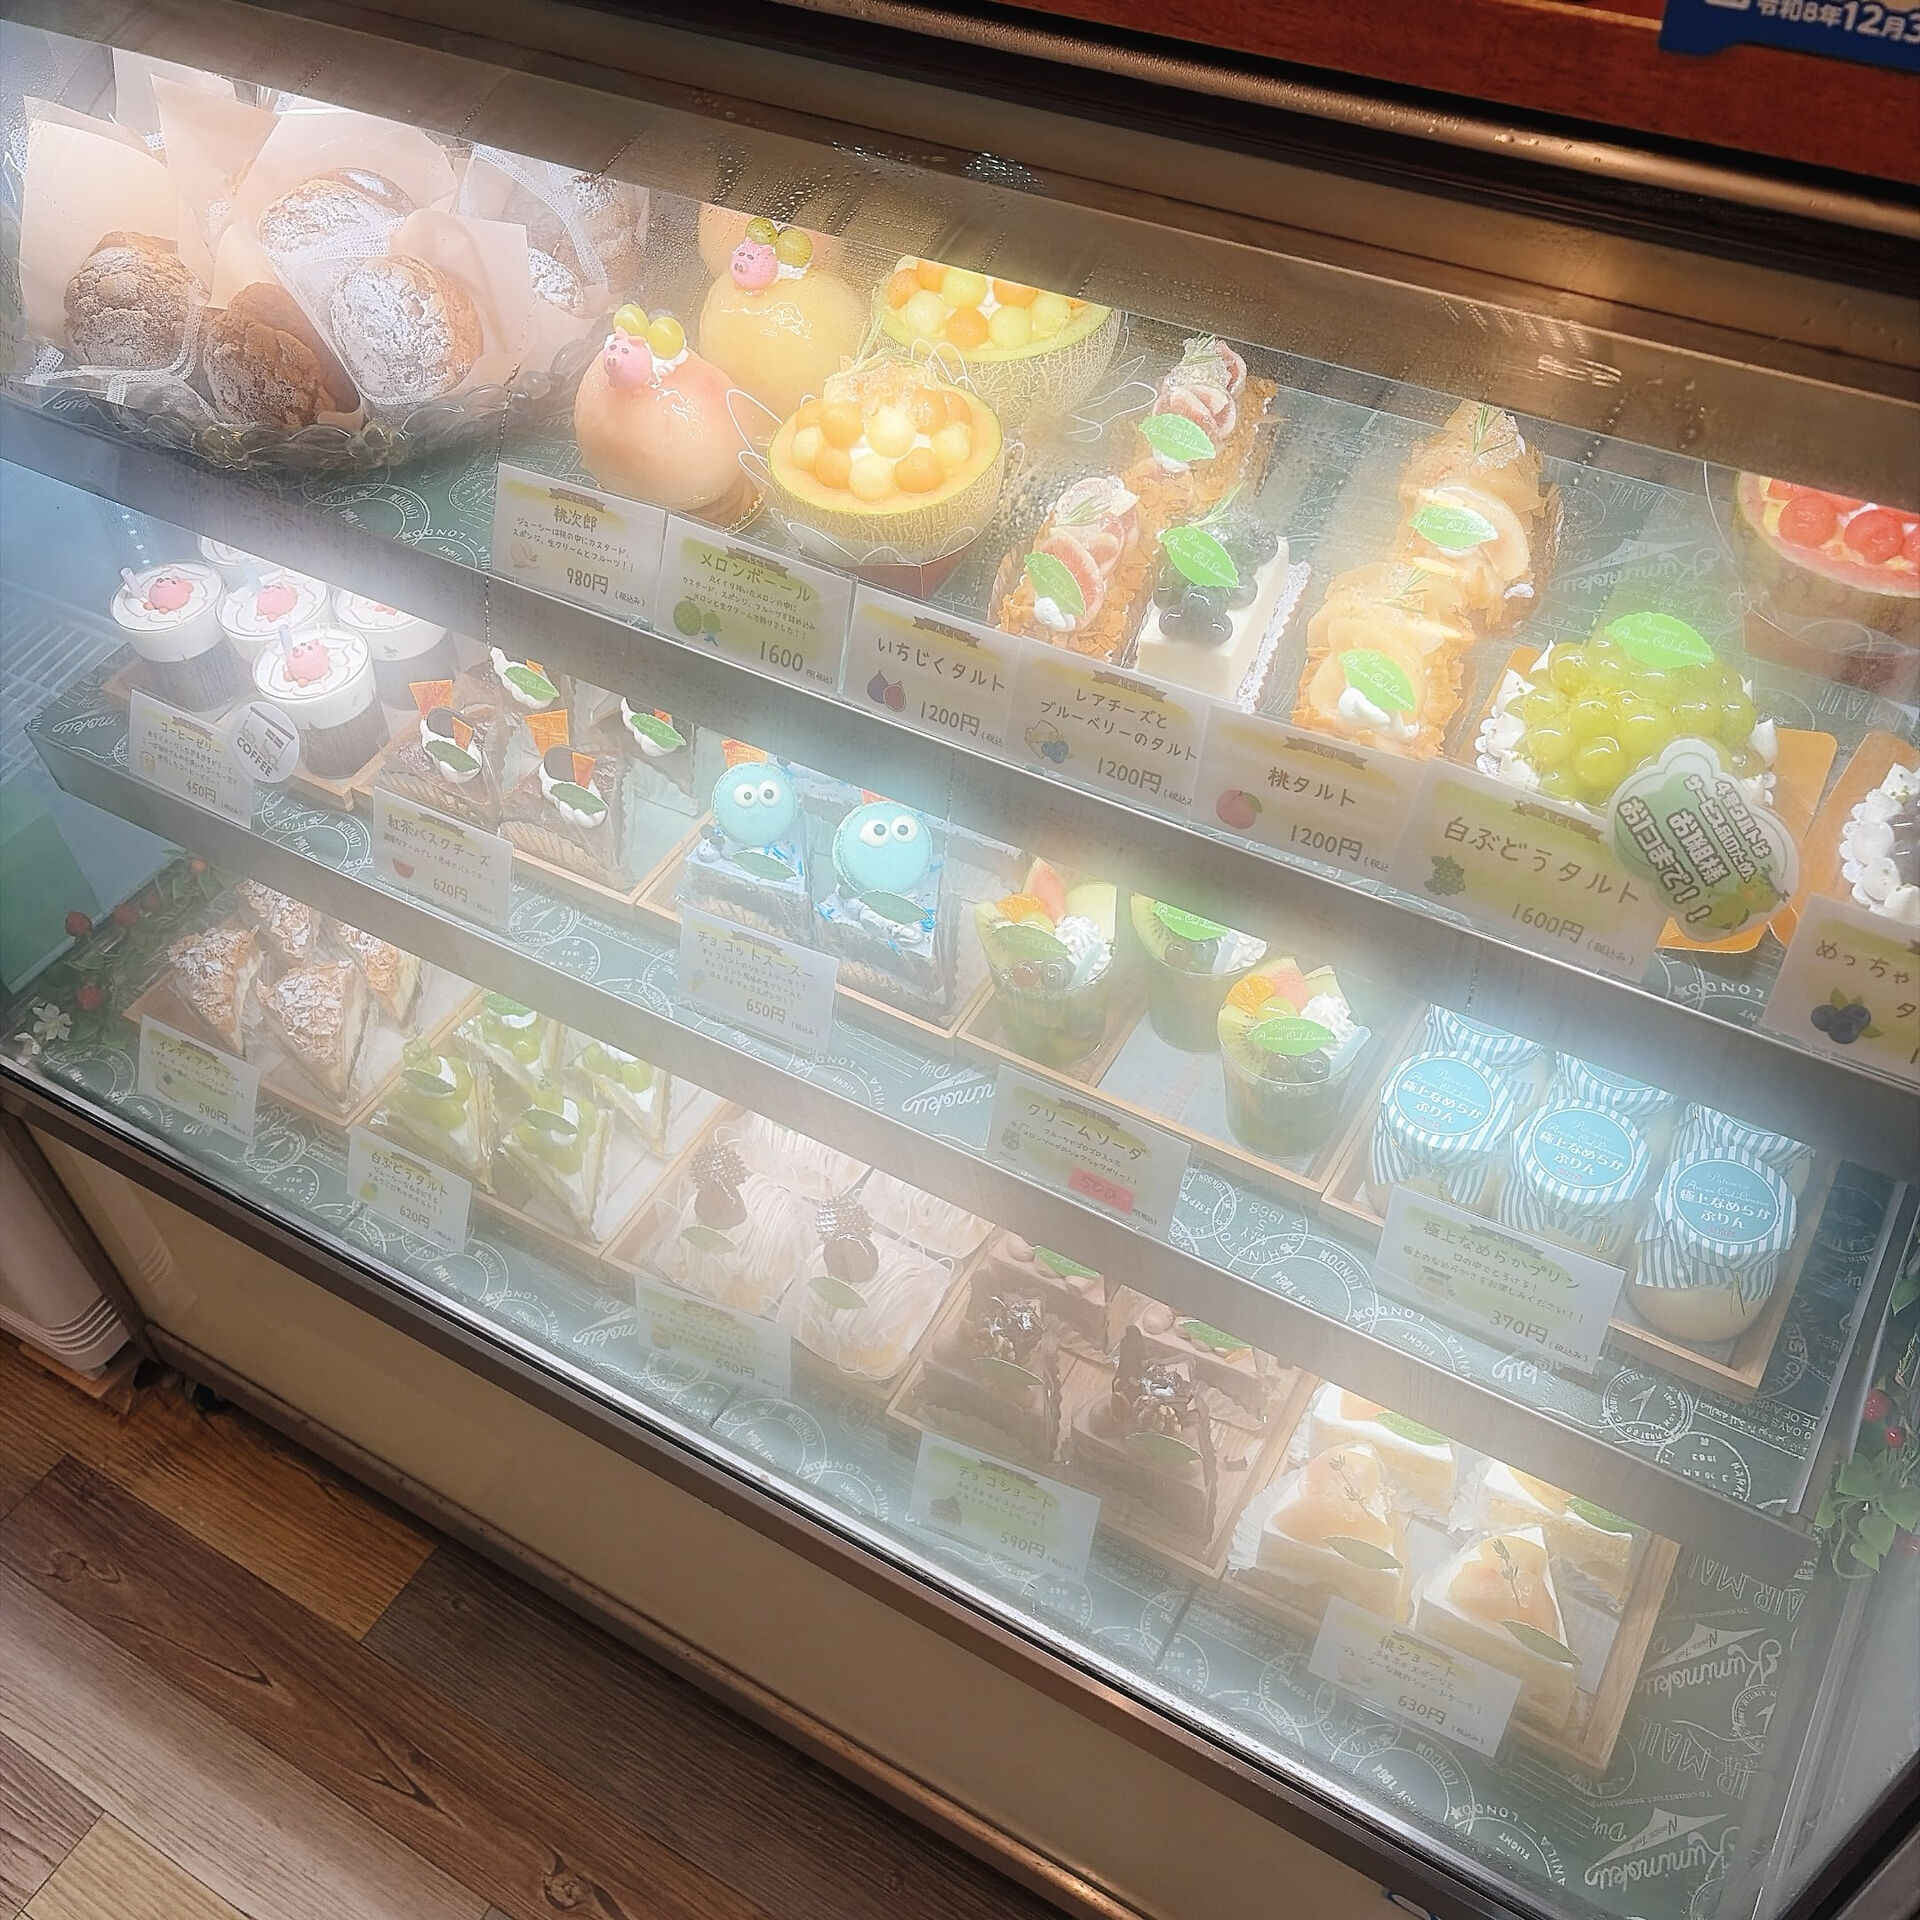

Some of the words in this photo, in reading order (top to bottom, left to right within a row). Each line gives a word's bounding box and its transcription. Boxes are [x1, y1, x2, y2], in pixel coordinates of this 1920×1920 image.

[554, 505, 598, 533] 桃次郎
[566, 567, 609, 595] 980円
[760, 640, 804, 672] 1600
[878, 637, 1005, 692] いちじくタルト
[920, 701, 981, 737] 1200円
[1075, 688, 1168, 729] レアチーズと
[160, 722, 222, 754] コーヒーゼリー
[1040, 701, 1197, 761] ブルーベリーのタルト
[236, 737, 273, 777] COFFEE
[1098, 757, 1162, 794] 1200円
[186, 780, 217, 804] 450円
[1267, 766, 1356, 807] 桃タルト
[1714, 780, 1772, 860] 4号タルトは
[387, 813, 493, 868] 紅茶バスクチーズ
[1290, 824, 1363, 862] 1200円
[1444, 815, 1639, 904] 白ぶどうタルト
[1666, 807, 1731, 887] お1組様
[433, 877, 469, 904] 620円
[1511, 903, 1585, 944] 1600円
[697, 930, 814, 978] チョコットスースー
[1815, 939, 1910, 985] めっちゃ
[746, 999, 786, 1024] 650円
[1896, 1002, 1917, 1019] タ
[199, 1102, 229, 1125] 590円
[1401, 1080, 1483, 1119] 極上なめらか
[1028, 1103, 1147, 1161] クリームソーダ
[1539, 1131, 1625, 1171] 極上なめらか
[371, 1151, 448, 1196] 白ぶどうタルト
[1080, 1174, 1117, 1200] 500
[400, 1205, 430, 1230] 620円
[1680, 1189, 1771, 1220] 極上なめらか
[1423, 1220, 1579, 1289] 極上なめらかプリン
[1489, 1310, 1549, 1345] 370円
[715, 1358, 755, 1380] 590円
[959, 1465, 1052, 1509] チョコショート
[999, 1531, 1046, 1559] 590円
[1379, 1637, 1457, 1678] 桃ショート
[1398, 1695, 1448, 1725] 630円
